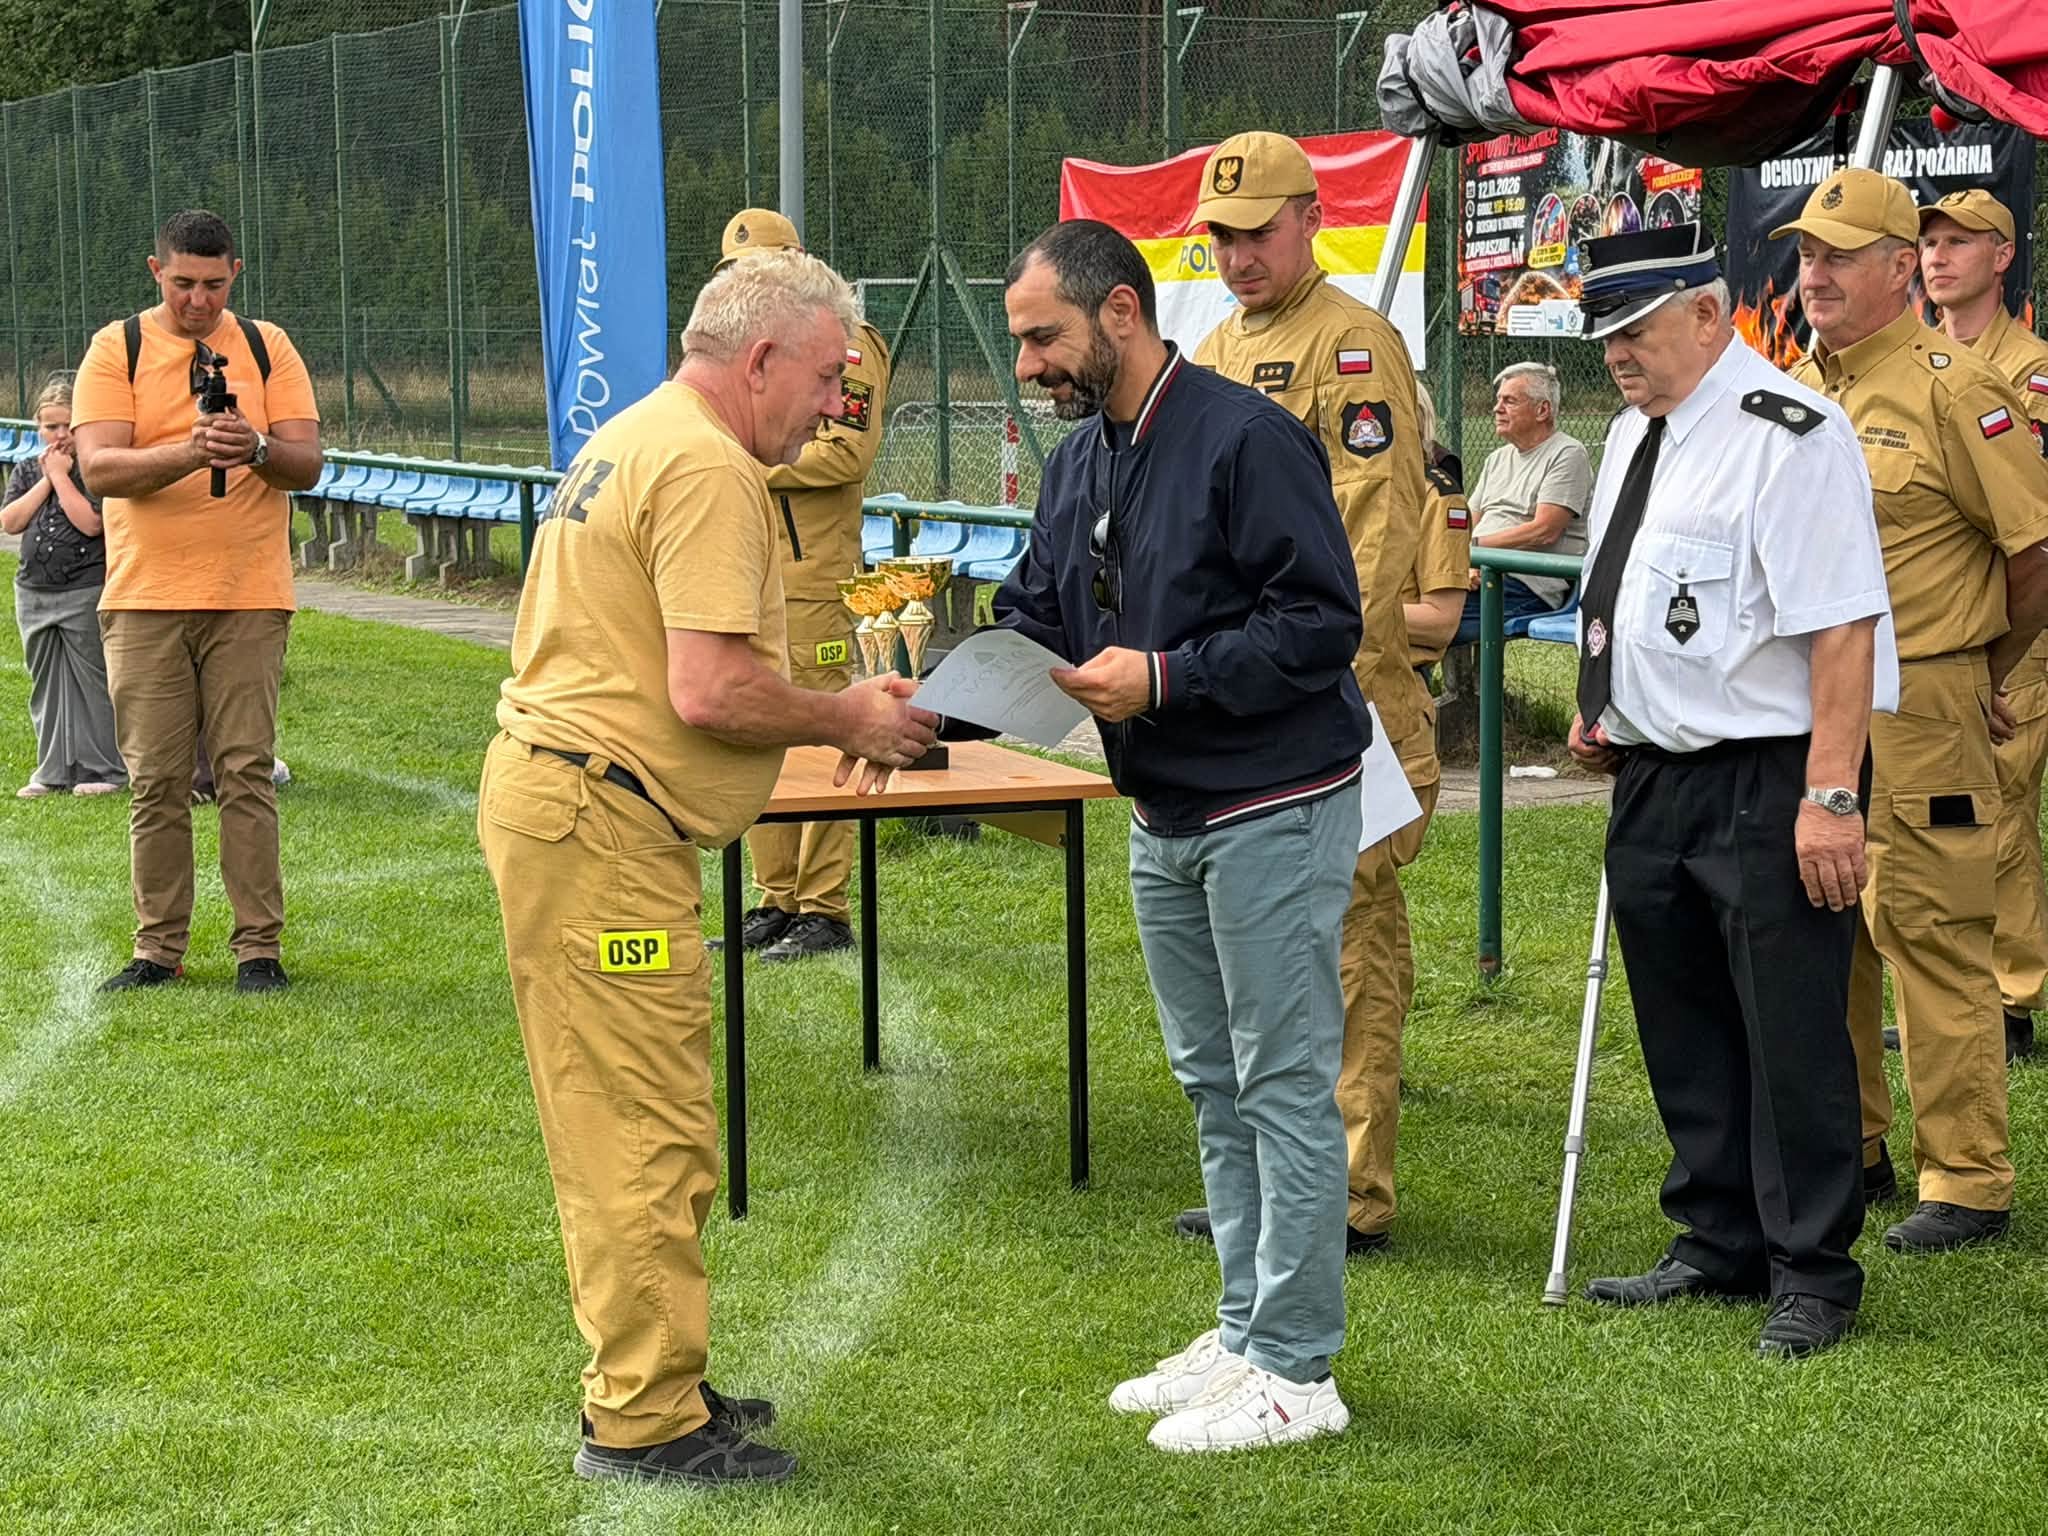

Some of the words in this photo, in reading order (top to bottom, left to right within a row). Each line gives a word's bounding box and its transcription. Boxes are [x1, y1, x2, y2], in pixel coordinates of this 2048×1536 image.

[1882, 144, 1913, 177] RAŻ
[1916, 142, 1993, 177] POŻARNA
[821, 645, 843, 661] OSP
[608, 938, 659, 966] OSP
